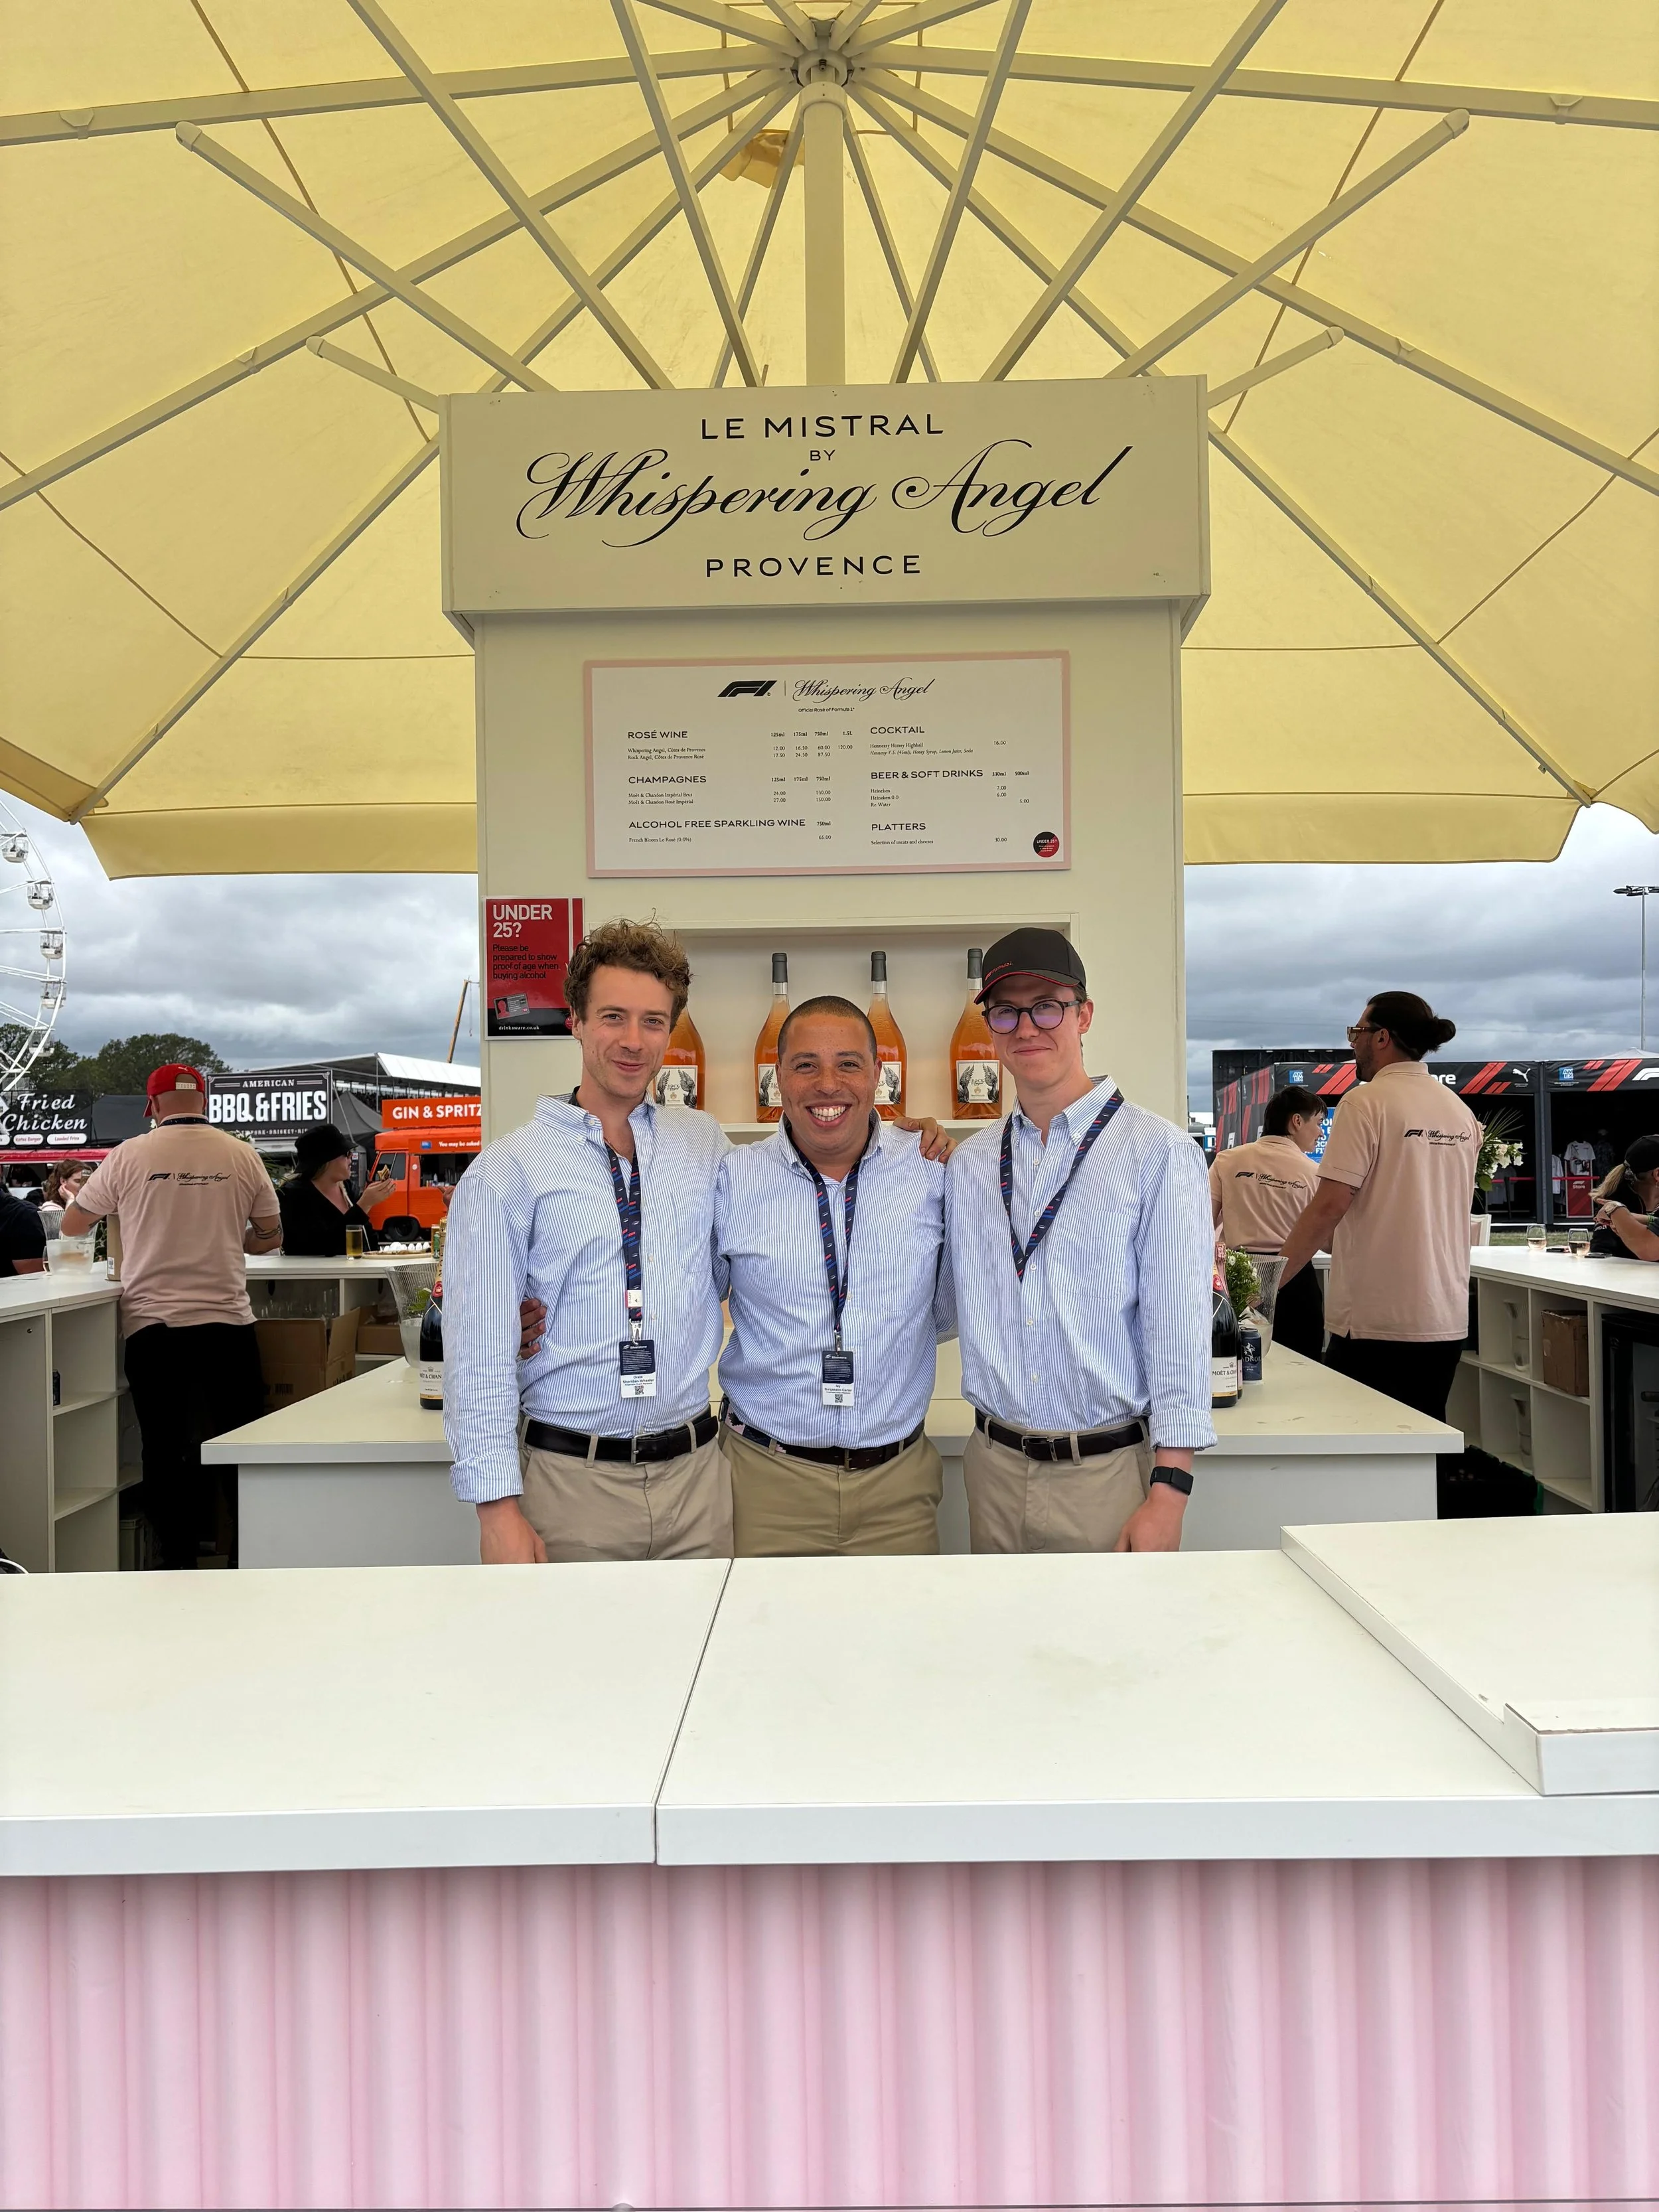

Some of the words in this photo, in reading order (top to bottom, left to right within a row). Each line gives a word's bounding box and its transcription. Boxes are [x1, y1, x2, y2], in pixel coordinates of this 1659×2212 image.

[701, 417, 745, 440] LE
[764, 413, 944, 438] MISTRAL
[810, 449, 835, 462] BY
[516, 447, 878, 548] Whispering
[891, 439, 1133, 538] Angel
[707, 554, 922, 578] PROVENCE
[792, 679, 878, 703] Whispering
[879, 677, 936, 701] Angel
[628, 730, 658, 739] ROSÉ
[493, 904, 553, 921] UNDER
[493, 922, 522, 938] 25?
[242, 1079, 295, 1088] AMERICAN
[17, 1092, 76, 1111] Fried
[208, 1092, 254, 1123] BBQ
[393, 1106, 419, 1119] GIN
[423, 1106, 433, 1118] &
[3, 1114, 88, 1132] Chicken
